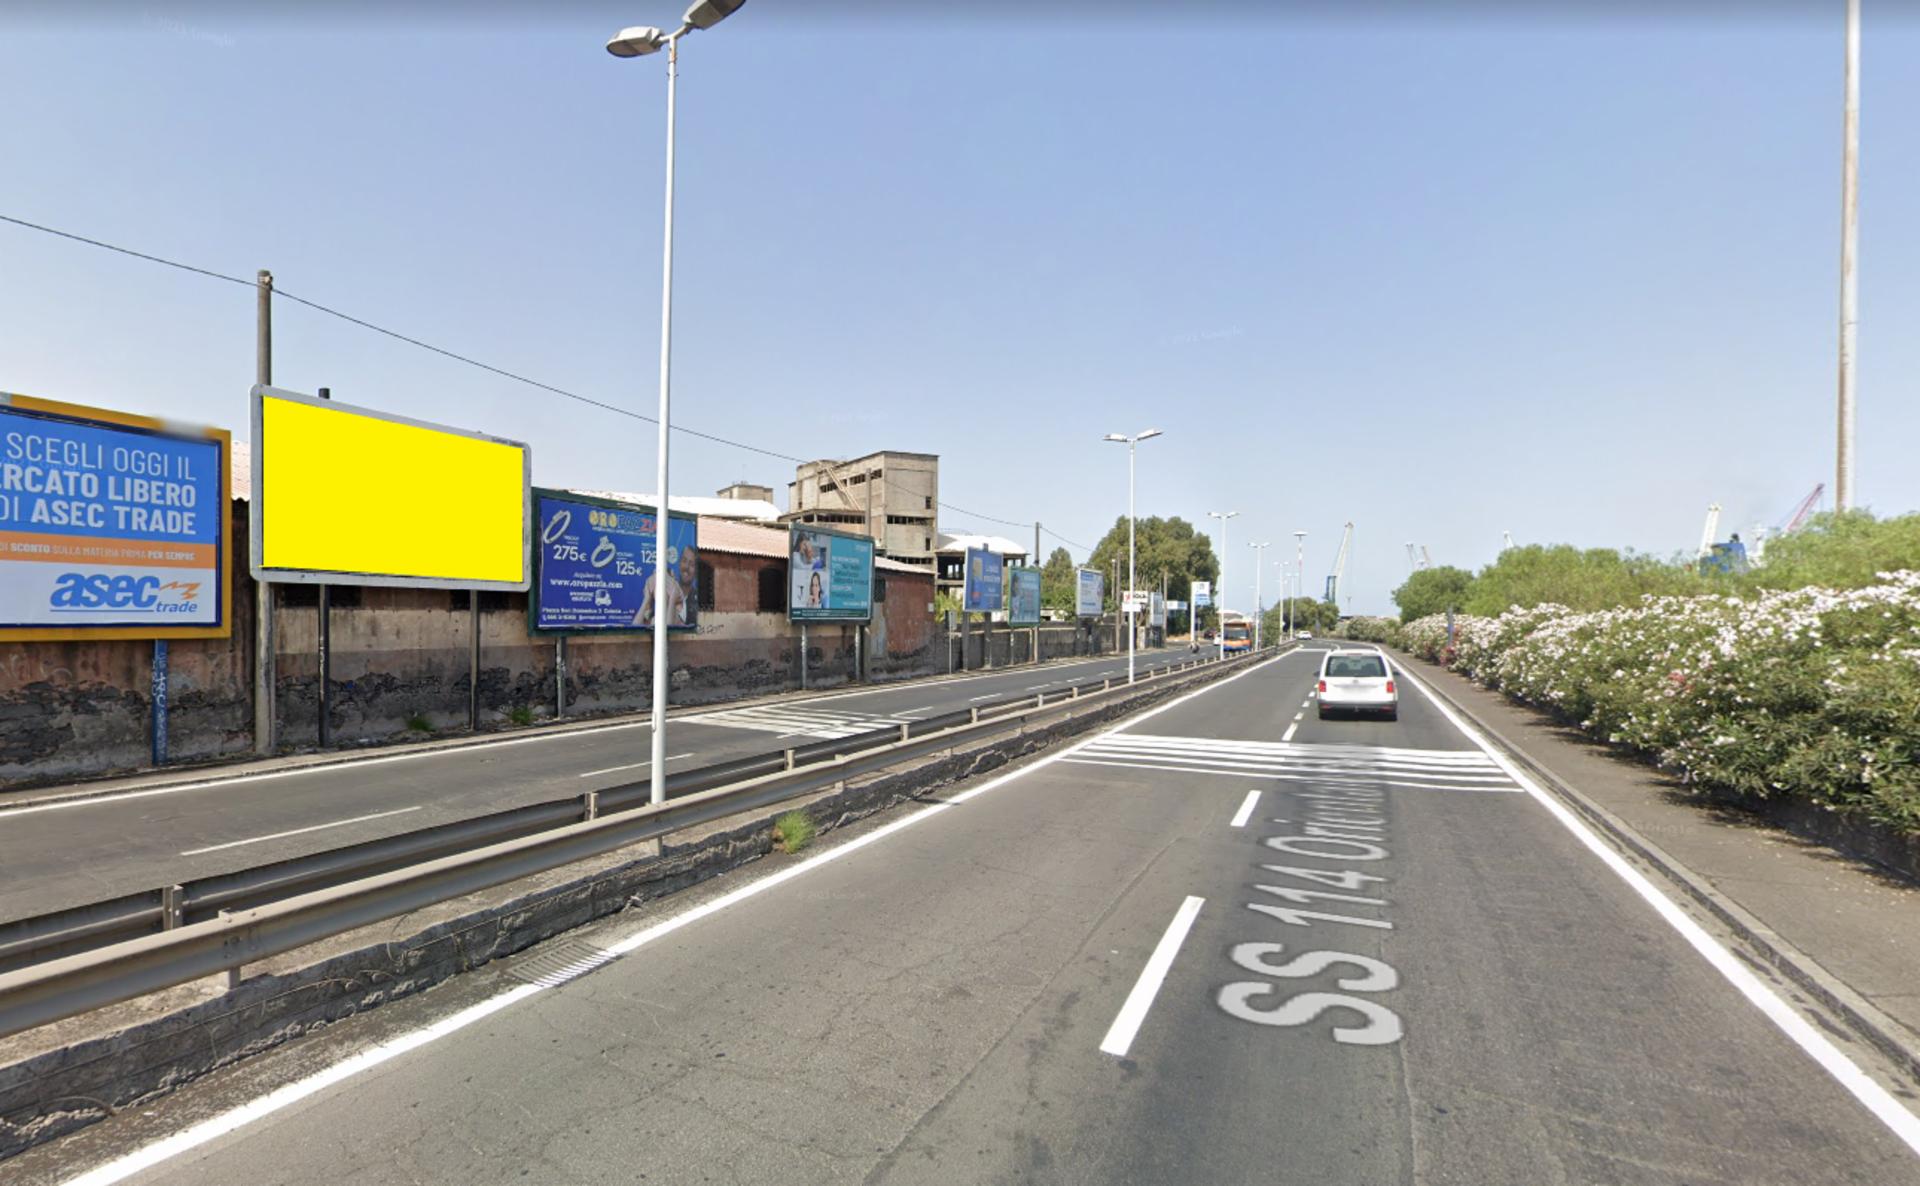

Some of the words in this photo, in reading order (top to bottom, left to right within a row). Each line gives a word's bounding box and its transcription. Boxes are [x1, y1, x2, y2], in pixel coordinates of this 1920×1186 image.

[7, 432, 102, 470] SCEGLI
[113, 446, 168, 477] OGGI
[177, 456, 197, 481] IL
[0, 462, 99, 498] RCATO
[107, 475, 197, 509] LIBERO
[31, 498, 105, 529] ASEC
[112, 505, 197, 536] TRADE
[10, 542, 51, 554] SCONTO
[50, 573, 161, 609] asec
[156, 600, 199, 613] trade
